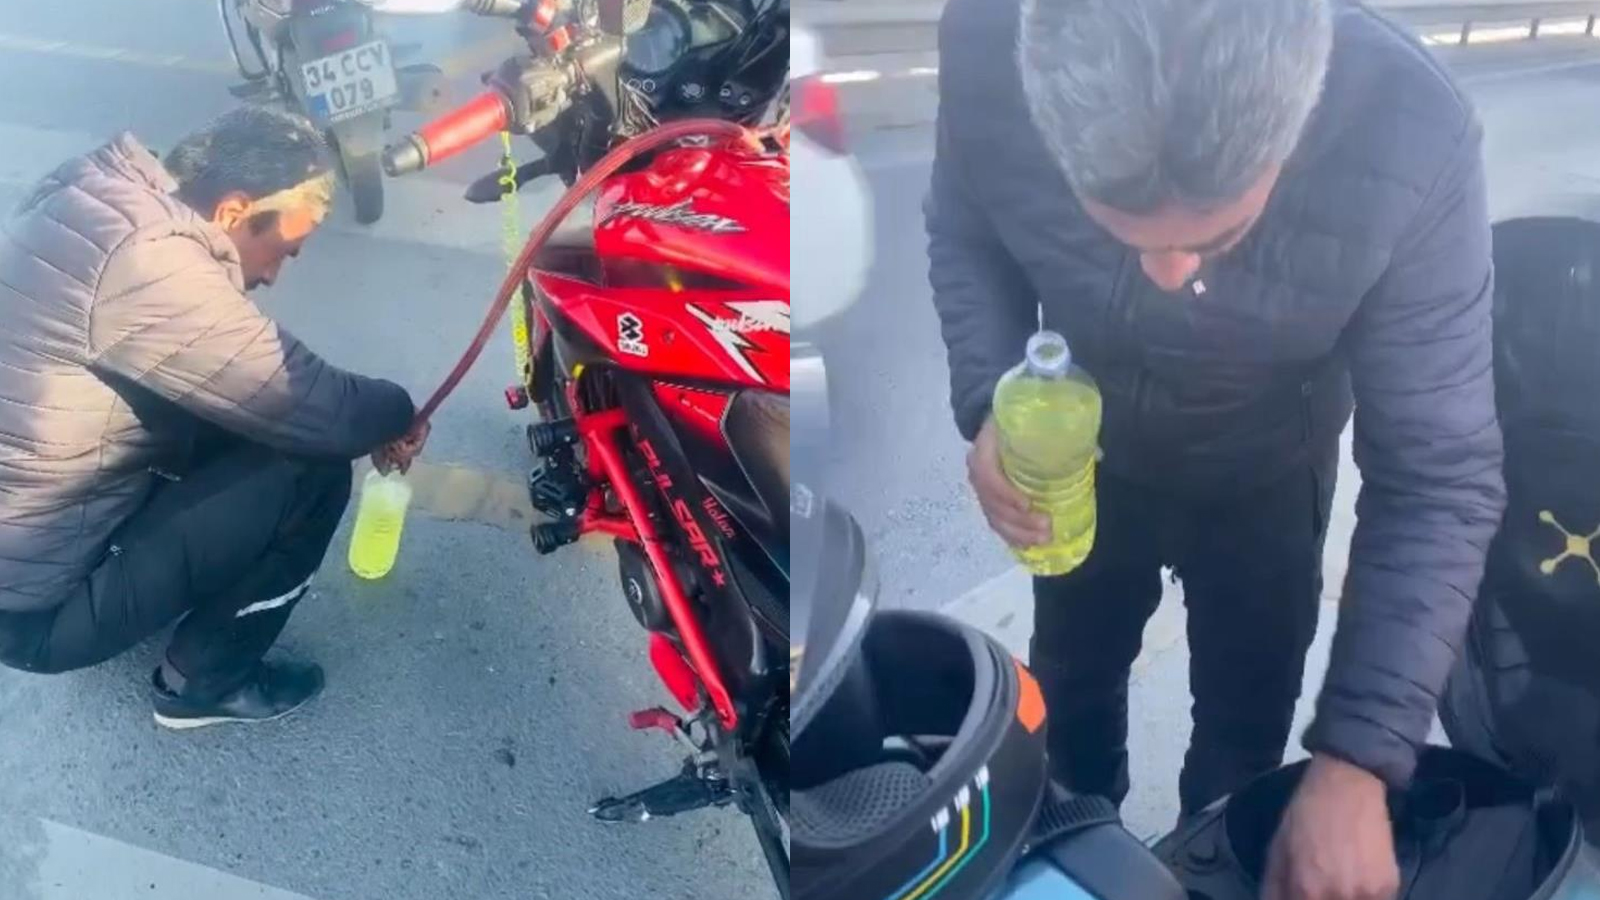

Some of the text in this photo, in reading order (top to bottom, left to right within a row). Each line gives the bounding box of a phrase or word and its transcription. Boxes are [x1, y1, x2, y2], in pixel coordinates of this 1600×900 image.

[306, 43, 384, 88] 34 CCY
[331, 77, 374, 110] 079
[637, 438, 721, 568] PULSAR
